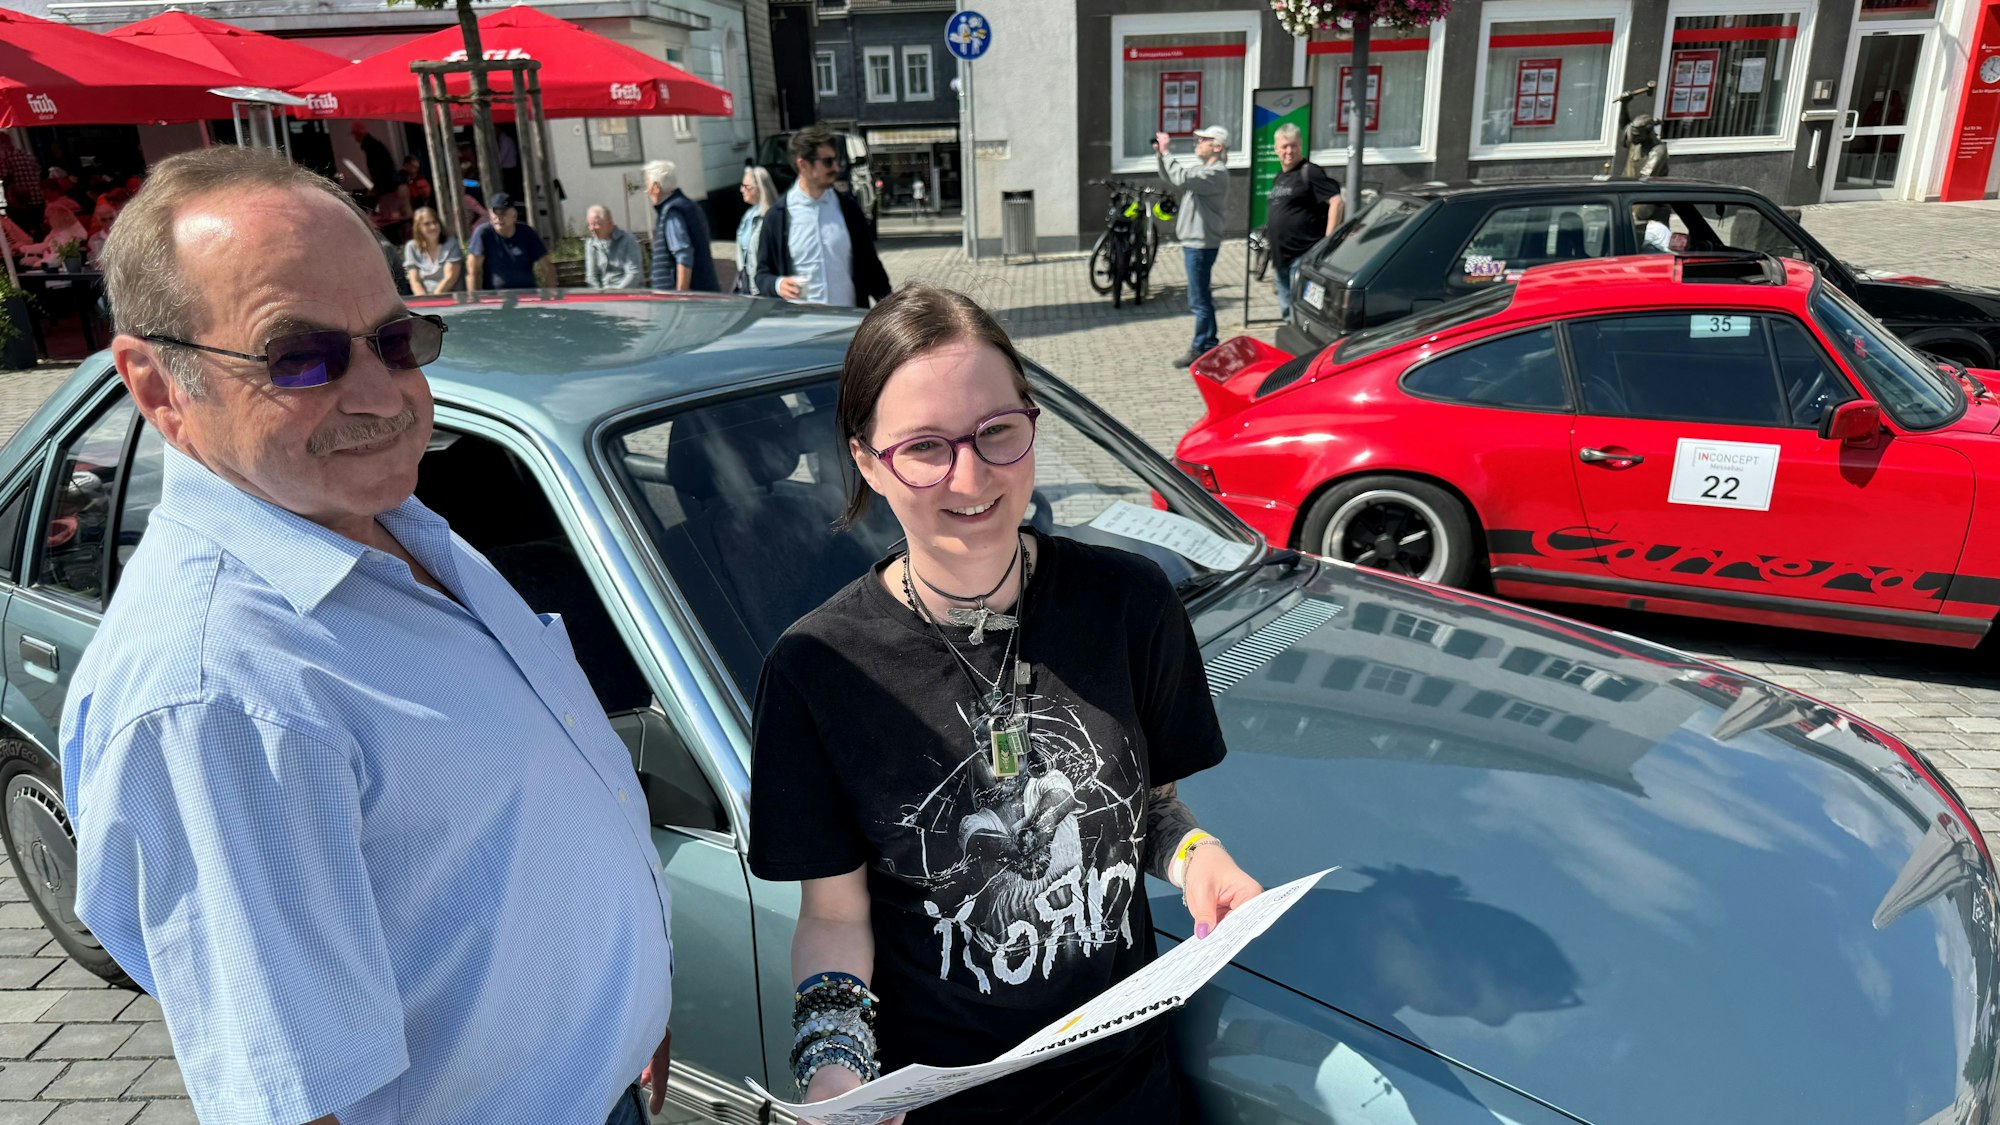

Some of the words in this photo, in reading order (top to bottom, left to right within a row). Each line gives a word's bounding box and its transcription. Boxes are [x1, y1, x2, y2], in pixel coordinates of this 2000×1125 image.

[26, 93, 58, 115] früh
[305, 92, 338, 110] früh
[1710, 317, 1732, 332] 35
[1698, 452, 1760, 466] INCONCEPT
[1700, 475, 1740, 500] 22
[1532, 523, 1942, 600] Carrera
